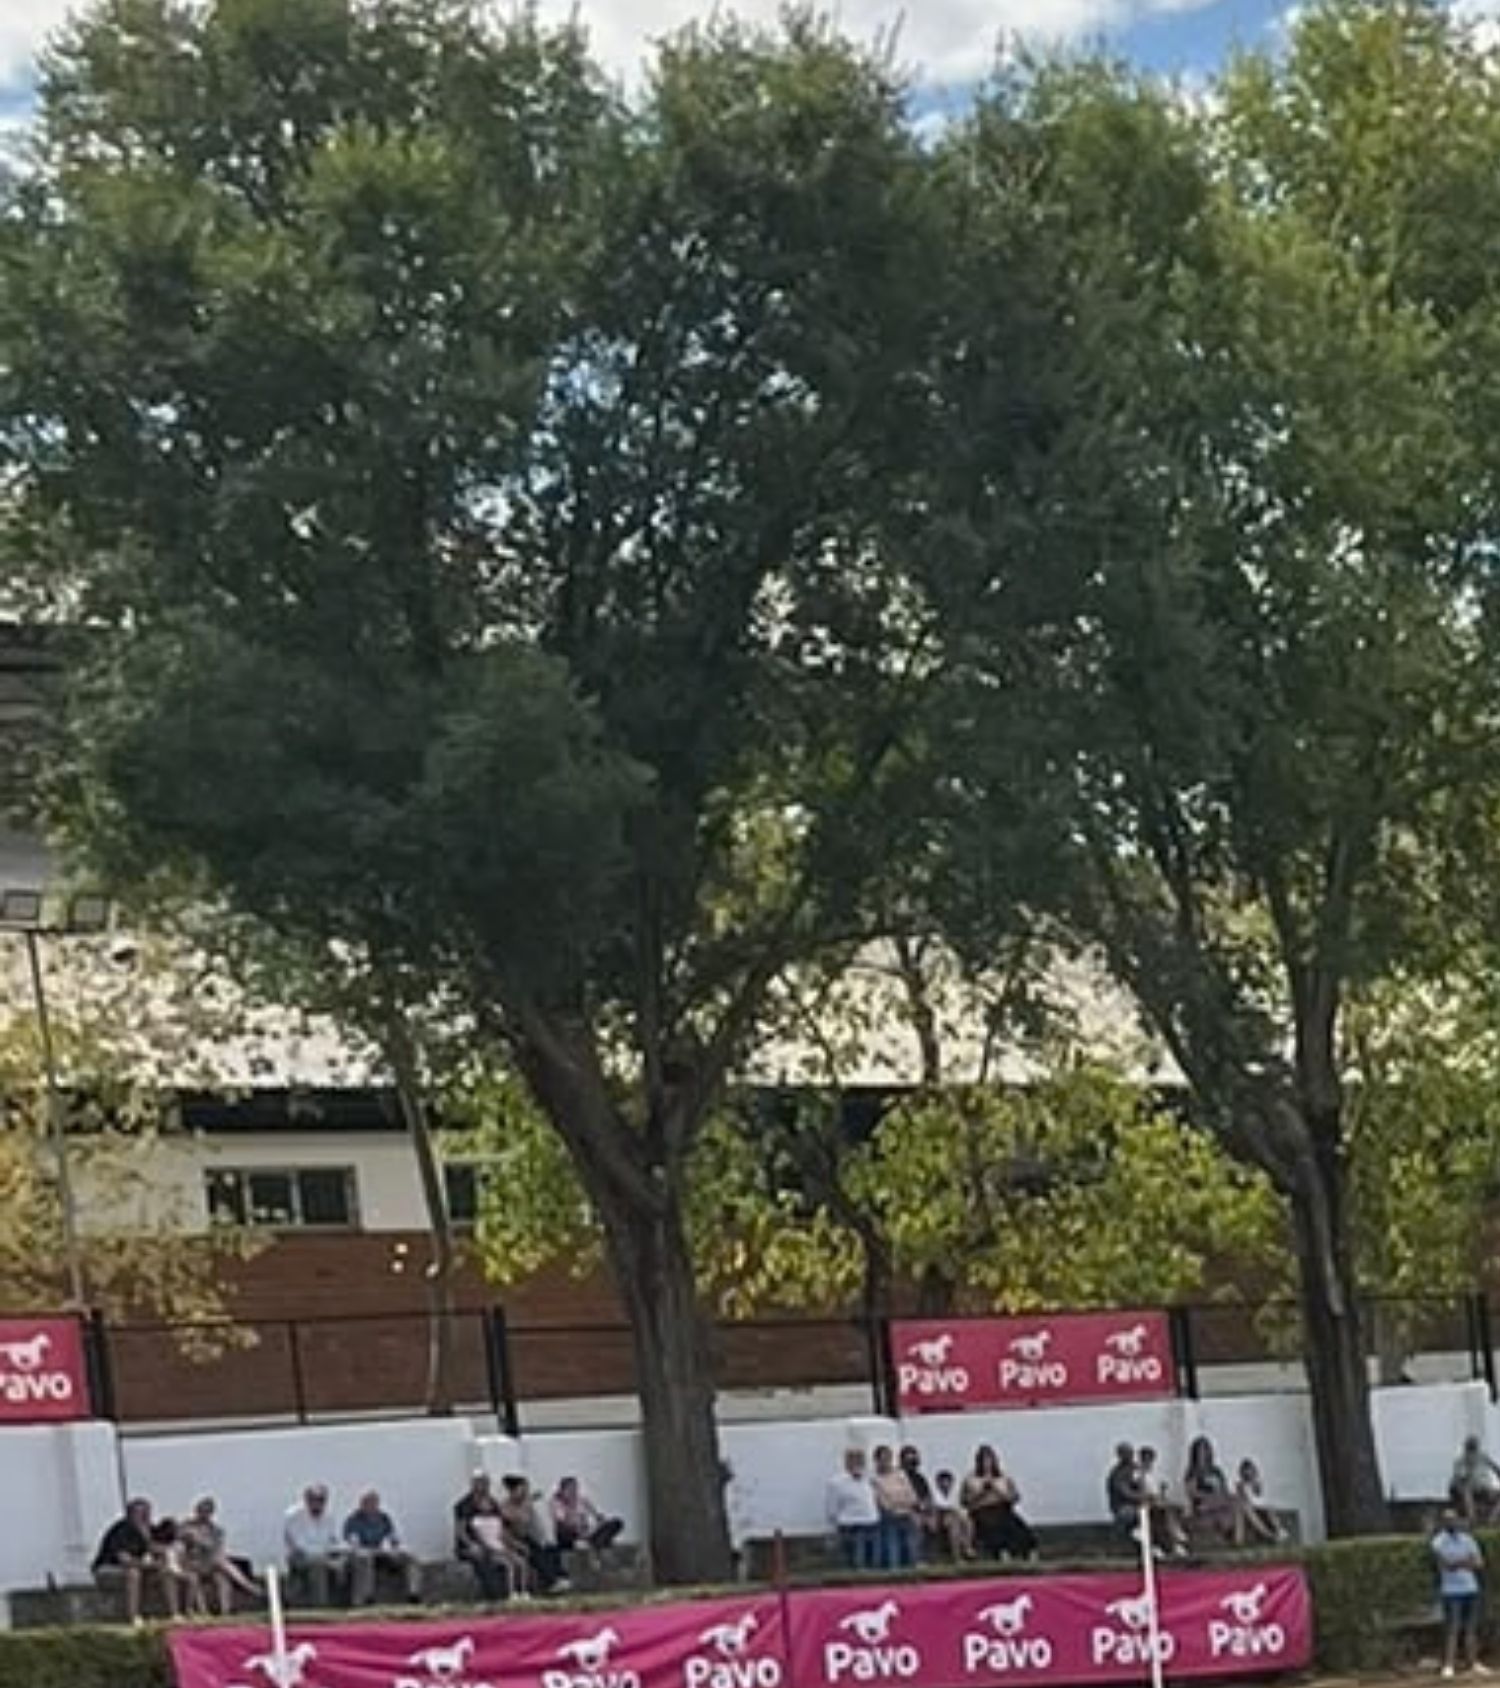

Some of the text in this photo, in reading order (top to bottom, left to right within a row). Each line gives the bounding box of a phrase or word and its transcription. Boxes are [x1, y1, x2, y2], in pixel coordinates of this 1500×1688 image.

[0, 1372, 73, 1403] avo
[899, 1354, 1162, 1395] Pavo Pavo Pavo
[824, 1643, 920, 1683] Pavo
[963, 1633, 1052, 1673] Pavo
[1207, 1619, 1286, 1657] Pavo
